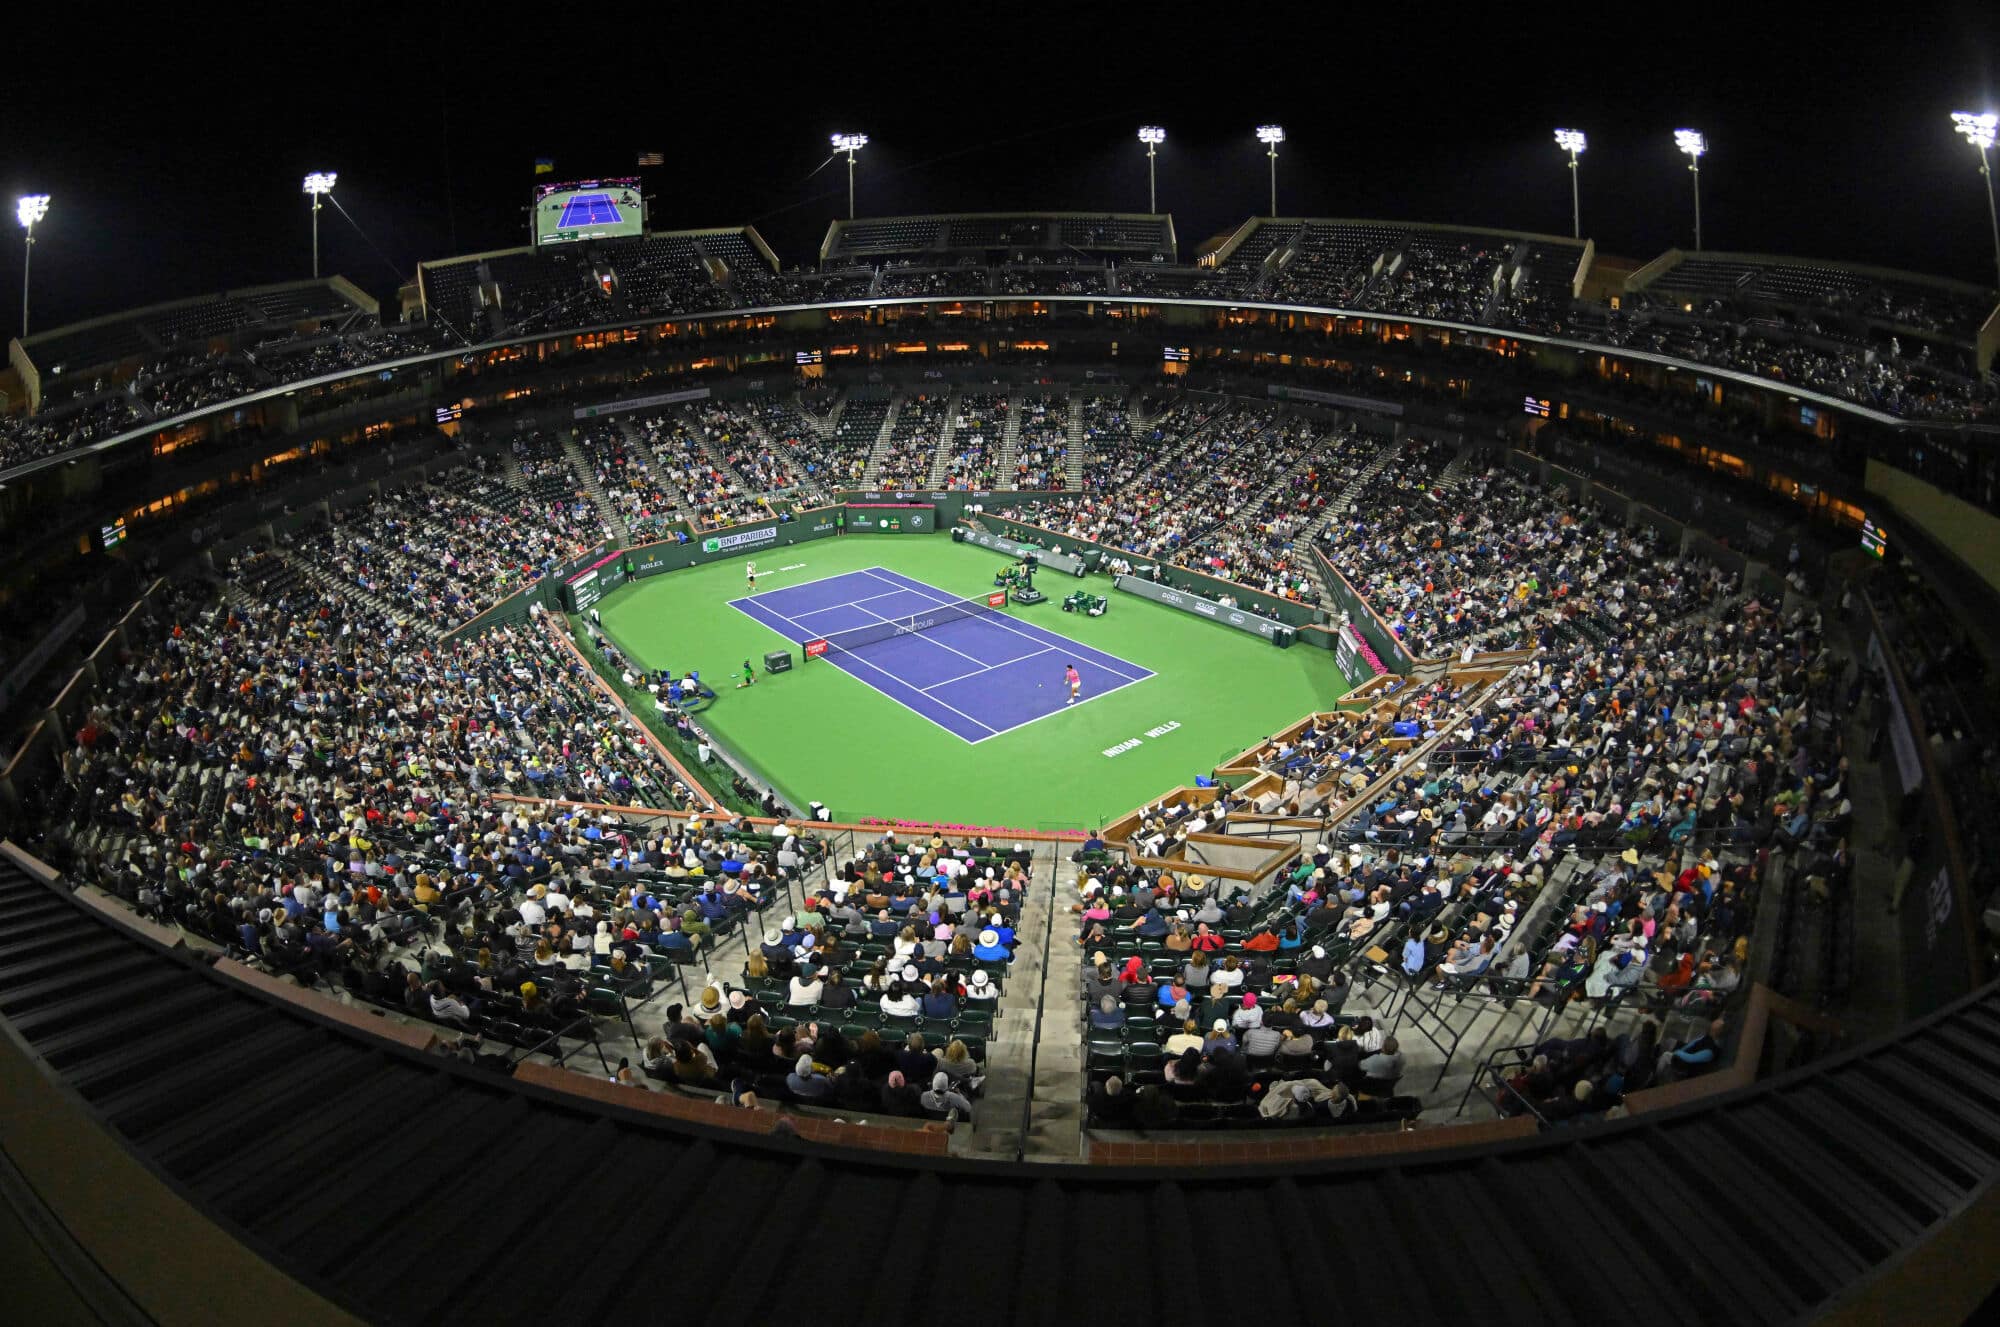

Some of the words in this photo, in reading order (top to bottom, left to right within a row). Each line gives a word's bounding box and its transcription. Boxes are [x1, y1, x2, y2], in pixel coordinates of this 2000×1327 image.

[813, 523, 834, 531] ROLEX
[720, 537, 738, 547] BNP
[740, 528, 774, 542] PARIBAS
[640, 560, 664, 570] ROLEX
[1101, 738, 1143, 758] INDIAN
[1144, 720, 1181, 738] WELLS
